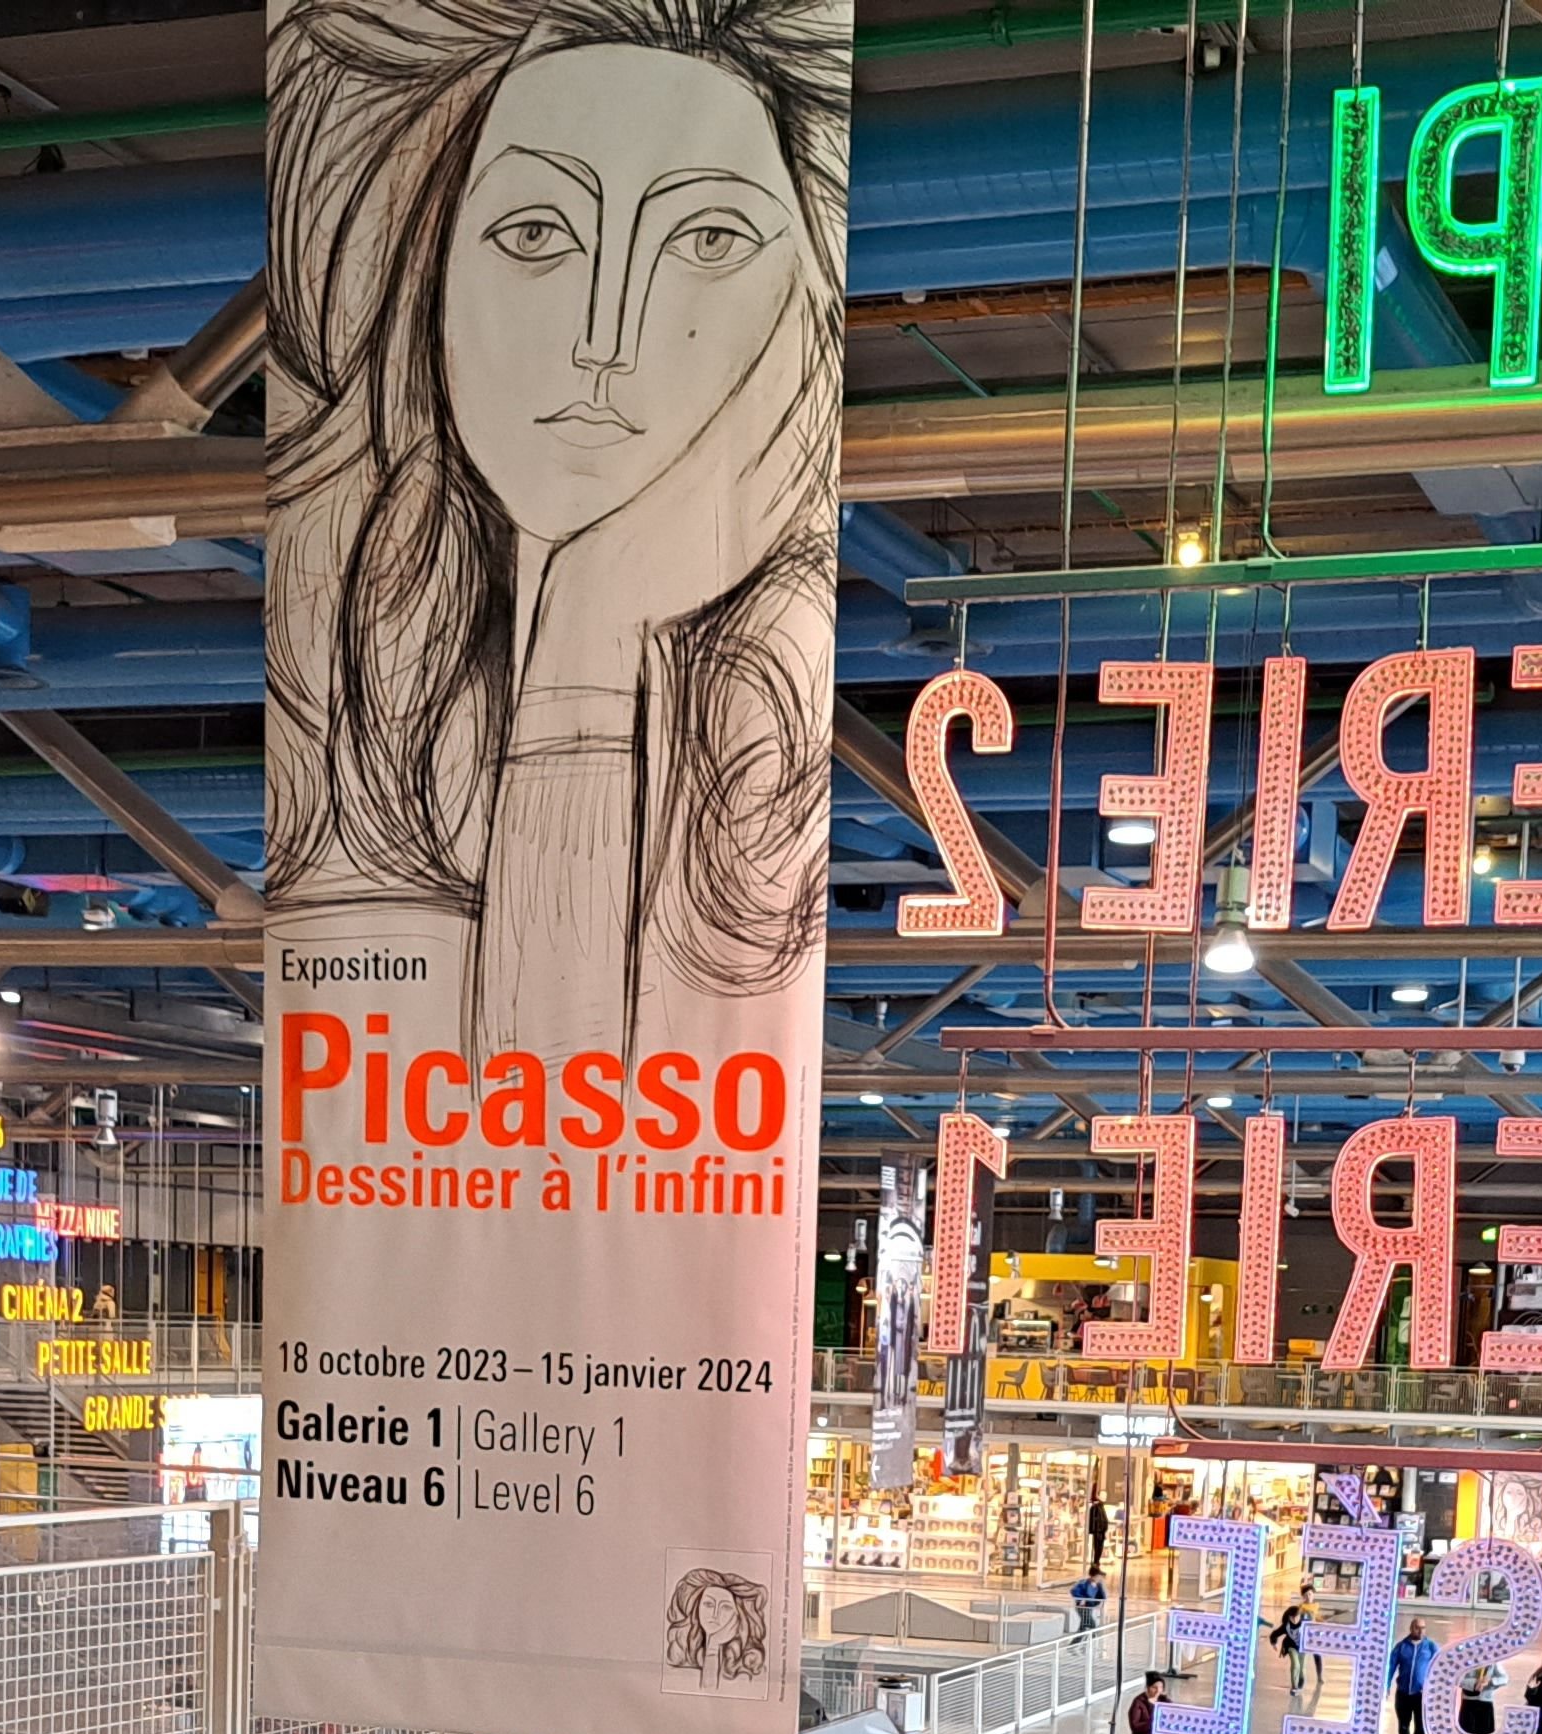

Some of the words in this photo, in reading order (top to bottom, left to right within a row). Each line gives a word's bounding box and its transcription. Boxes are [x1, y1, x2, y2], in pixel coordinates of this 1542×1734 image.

[281, 948, 429, 988] Exposition
[280, 1012, 787, 1151] Picasso
[280, 1148, 521, 1211] Dessiner
[541, 1151, 572, 1211] à
[35, 1200, 121, 1240] MEZZANINE
[72, 1287, 84, 1322] 2
[37, 1340, 97, 1377] PETITE
[100, 1340, 152, 1375] SALLE
[278, 1343, 309, 1375] 18
[318, 1345, 427, 1380] octobre
[583, 1354, 687, 1394] janvier
[697, 1357, 774, 1394] 2024
[84, 1394, 155, 1432] GRANDE
[276, 1401, 411, 1448] Galerie
[426, 1407, 444, 1447] 1
[473, 1408, 595, 1465] Gallery
[612, 1417, 626, 1457] 1
[275, 1458, 409, 1506] Niveau
[422, 1466, 448, 1507] 6
[473, 1471, 561, 1515] Level
[576, 1476, 597, 1516] 6
